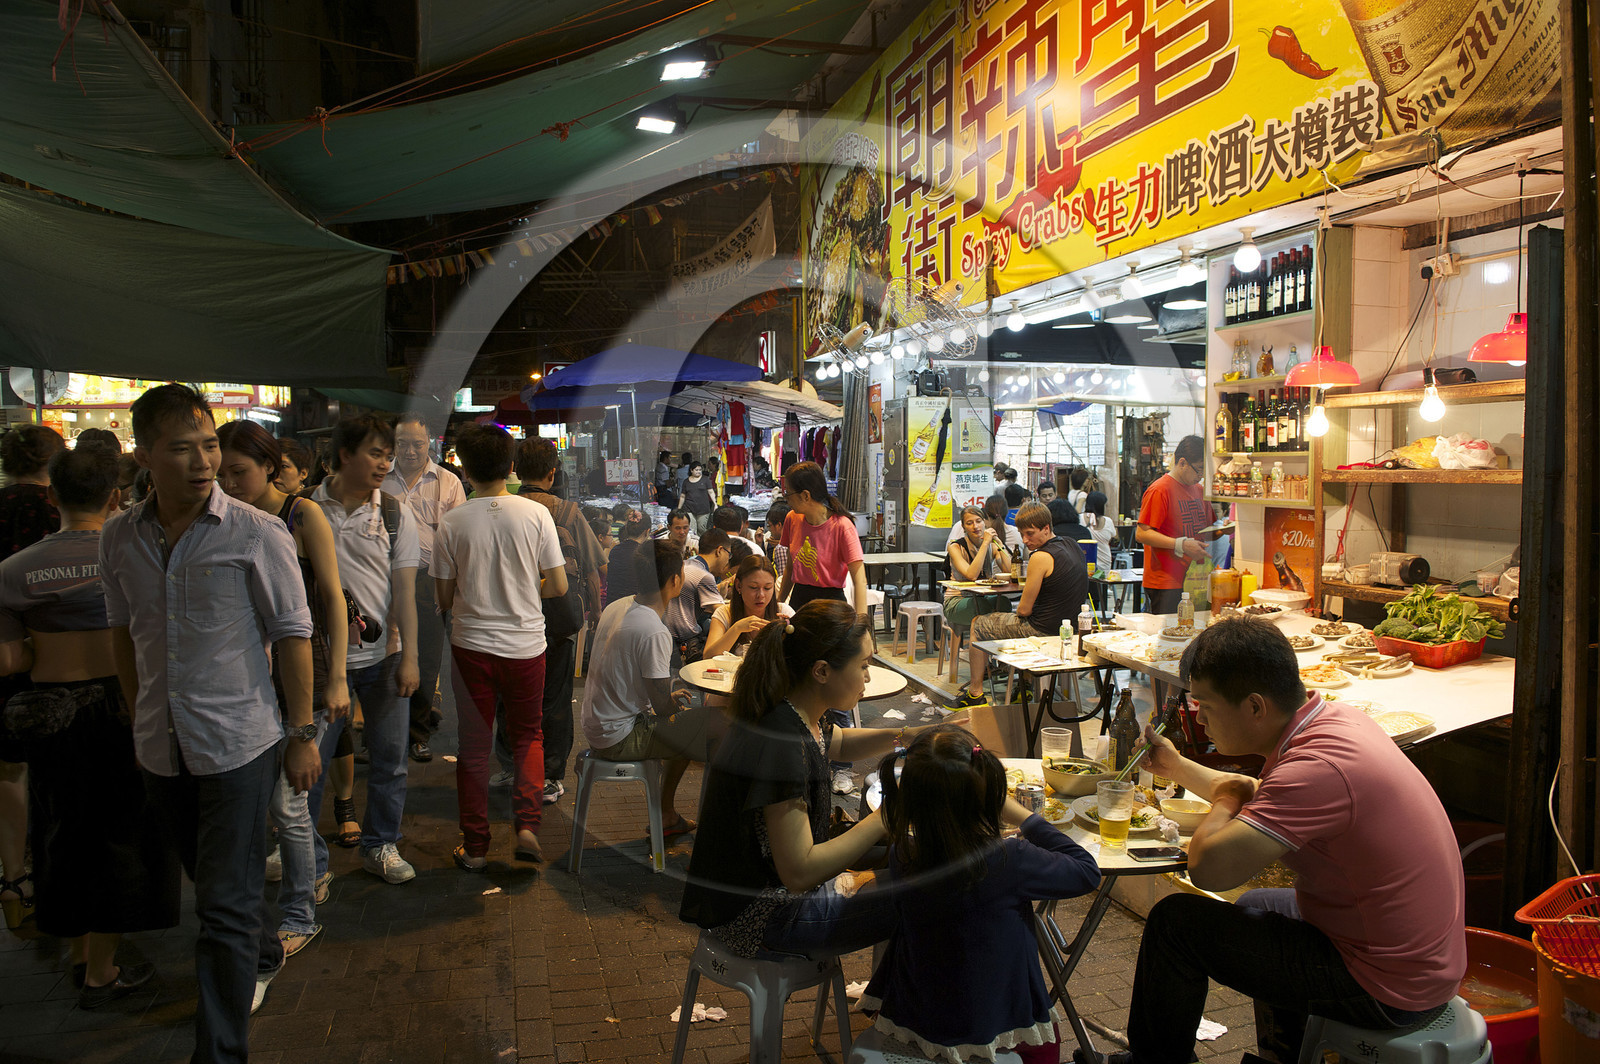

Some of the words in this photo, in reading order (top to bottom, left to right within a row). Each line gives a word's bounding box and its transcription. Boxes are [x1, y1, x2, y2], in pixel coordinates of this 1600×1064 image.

[1505, 15, 1557, 81] PREMIUM
[1508, 72, 1527, 92] FROM
[1527, 58, 1539, 72] THE
[1539, 32, 1557, 58] FINEST
[1528, 69, 1540, 84] NET
[1396, 76, 1456, 132] San
[1094, 84, 1378, 247] 生力啤酒大樽裝
[960, 225, 1012, 281] Spicy
[1016, 187, 1085, 253] Crabs
[25, 565, 80, 585] PERSONAL
